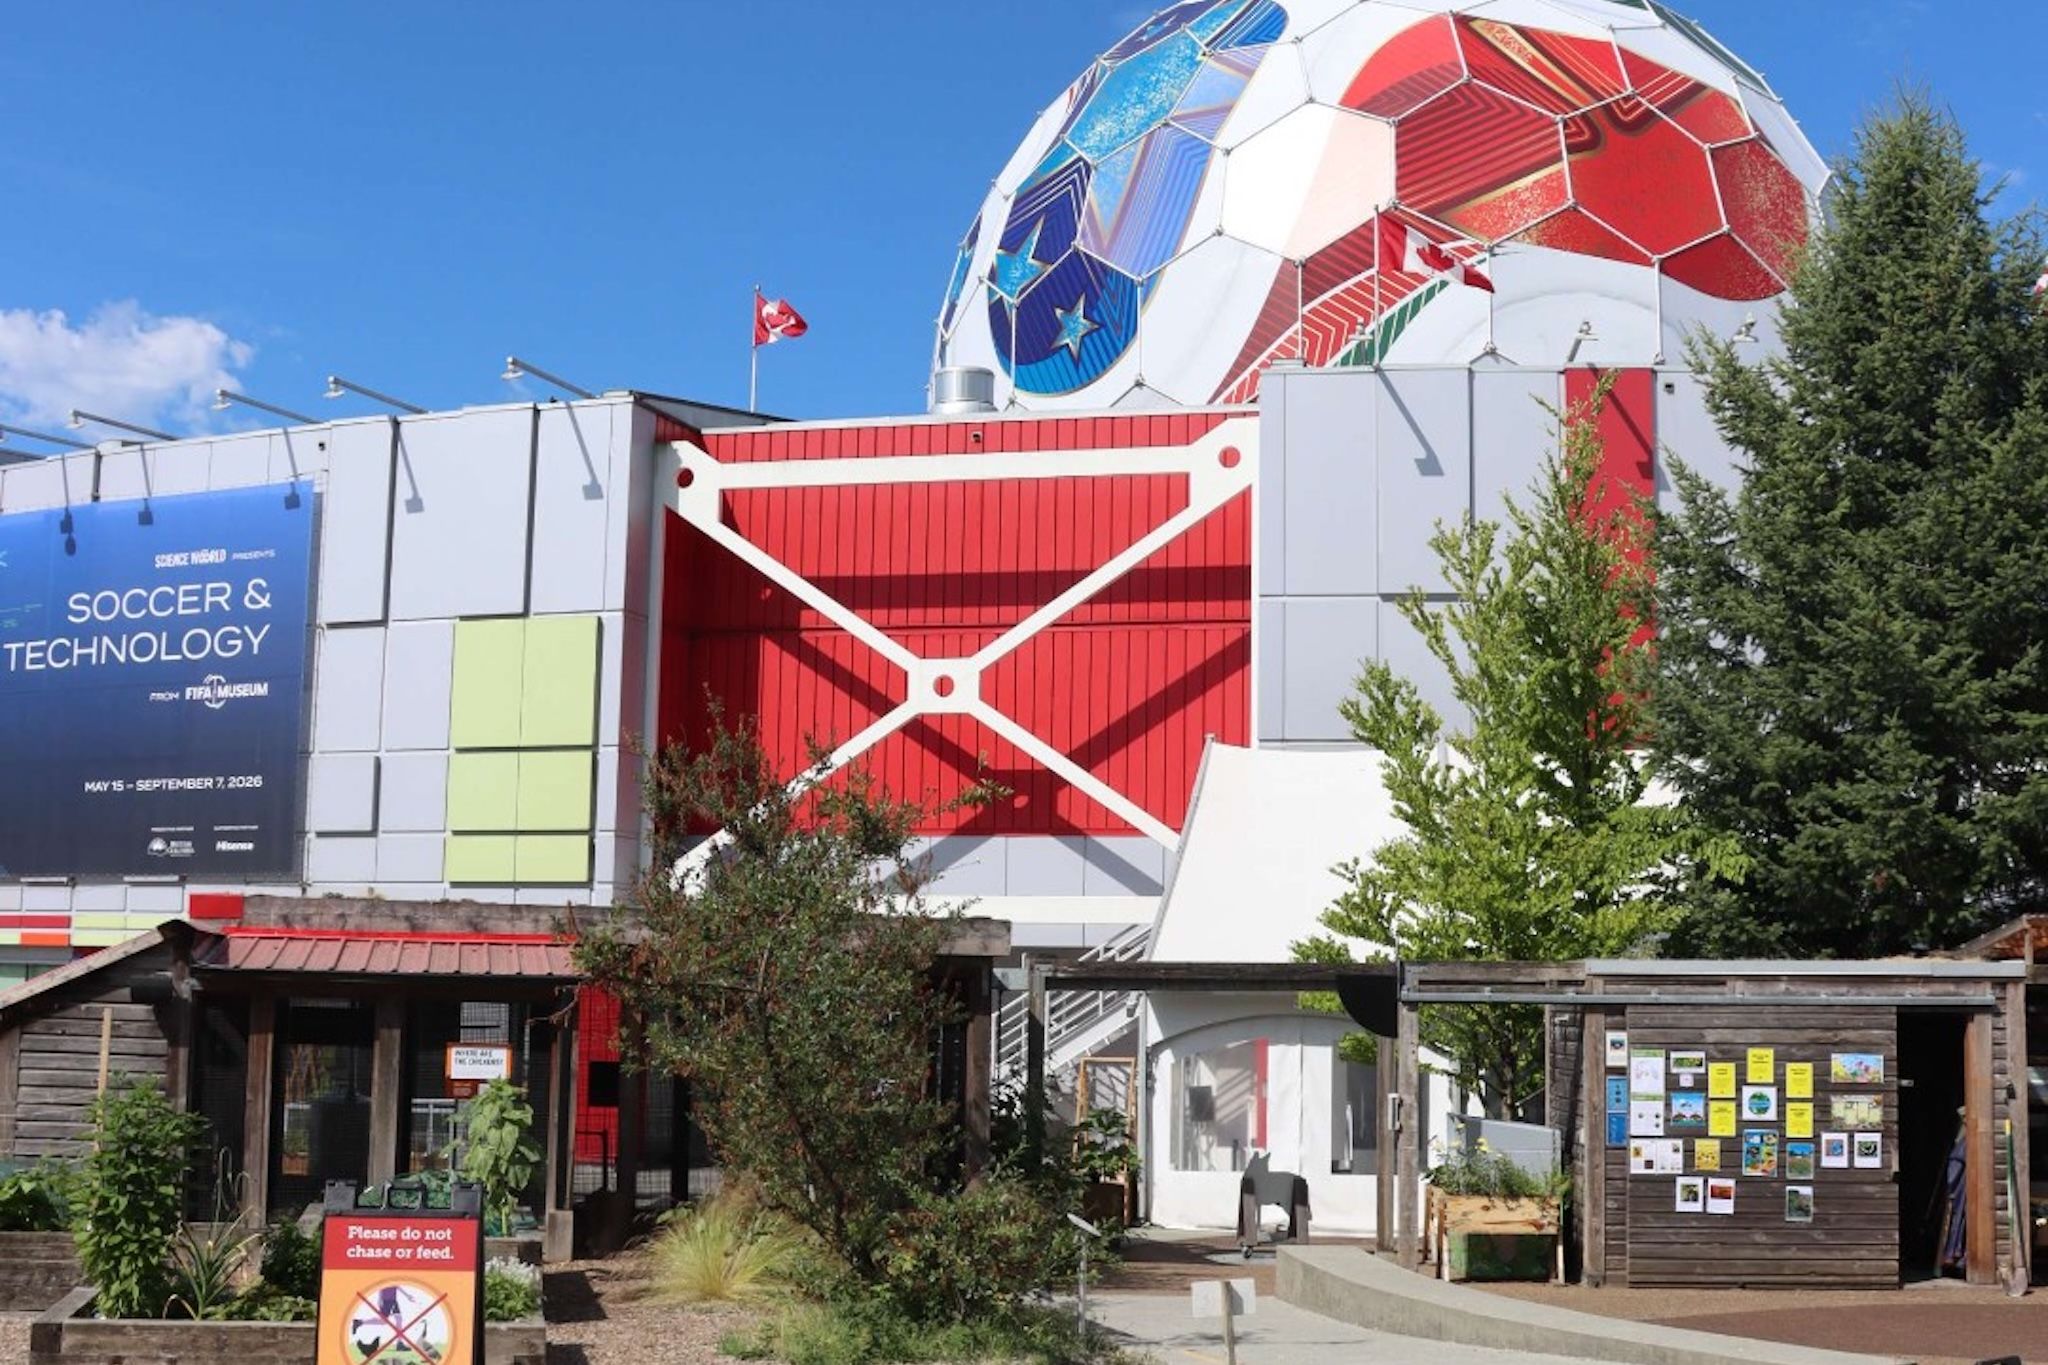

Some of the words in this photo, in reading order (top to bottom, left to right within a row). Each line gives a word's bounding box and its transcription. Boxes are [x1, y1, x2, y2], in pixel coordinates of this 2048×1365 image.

[154, 553, 189, 568] SCIENCE
[67, 581, 232, 624] SOCCER
[243, 578, 272, 609] &
[3, 623, 271, 672] TECHNOLOGY
[185, 686, 212, 700] FIFA
[217, 682, 268, 699] MUSEUM
[84, 781, 110, 792] MAY
[112, 780, 124, 791] 15
[136, 777, 213, 791] SEPTEMBER
[215, 776, 225, 789] 7,
[227, 775, 263, 788] 2026
[215, 840, 254, 851] Hisense
[348, 1225, 398, 1240] Please
[401, 1226, 421, 1240] do
[424, 1228, 452, 1240] not
[346, 1244, 392, 1258] chase
[395, 1248, 414, 1259] or
[416, 1245, 454, 1260] feed.
